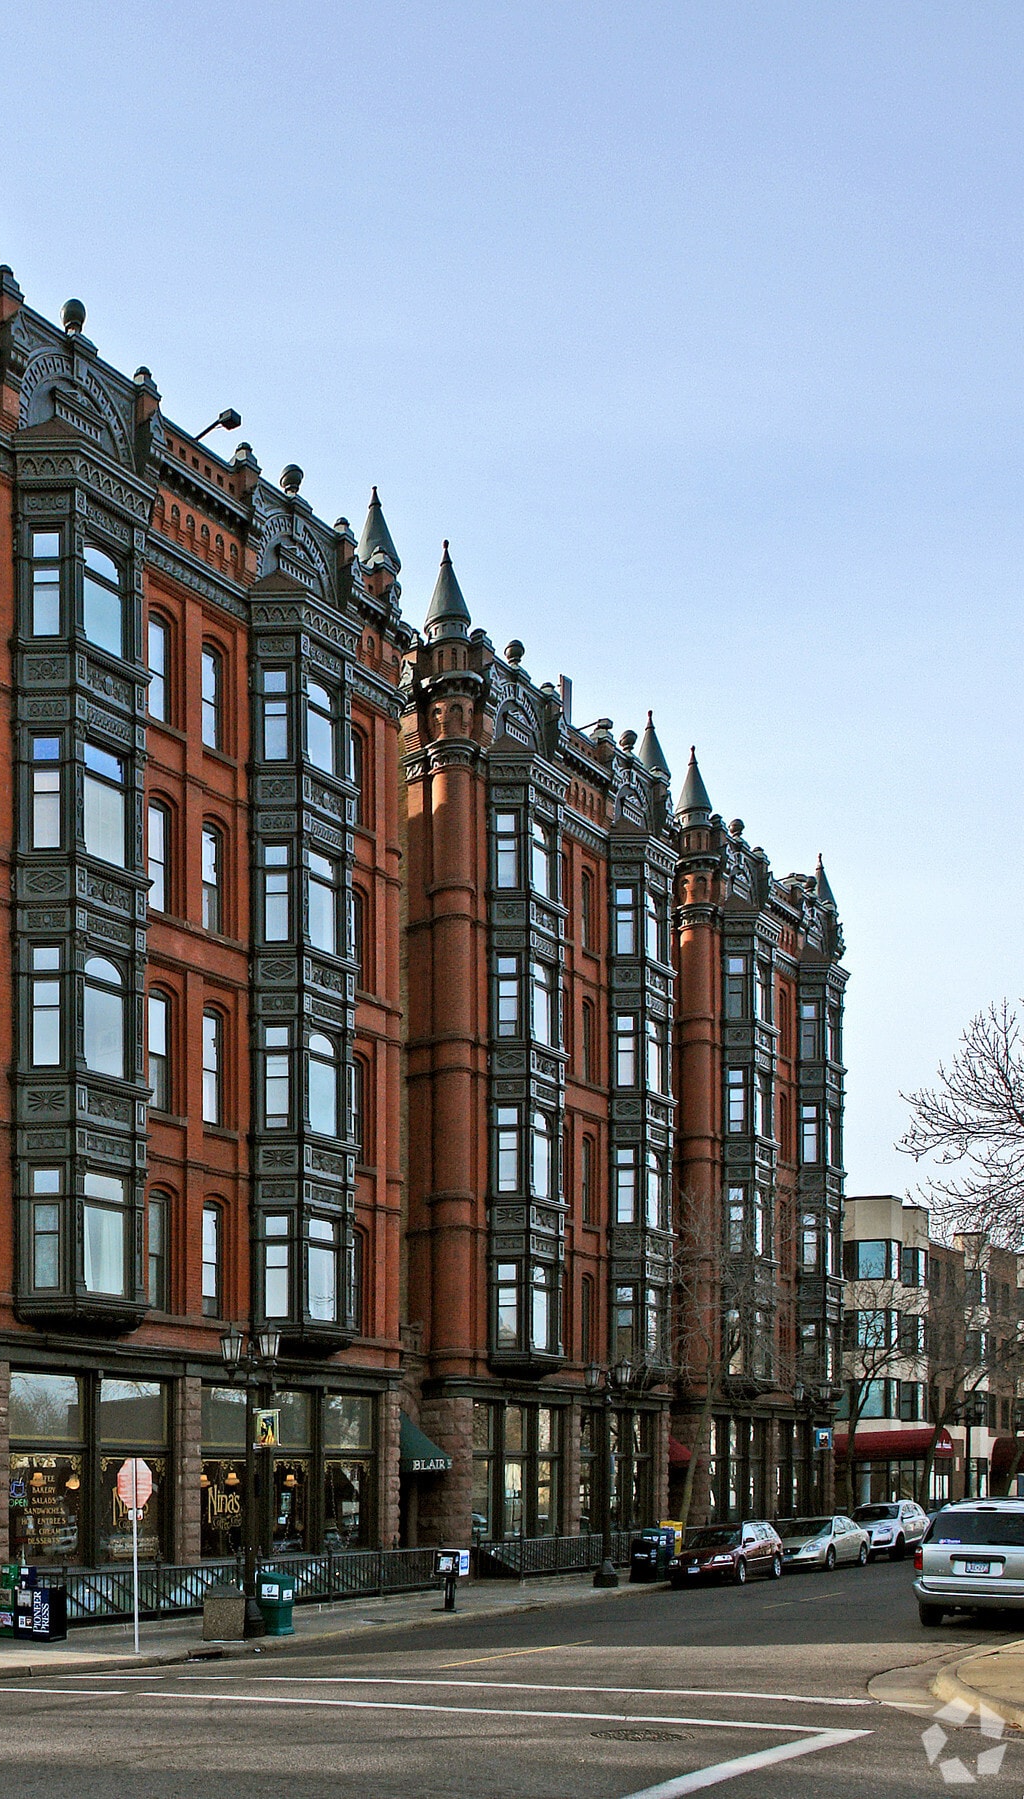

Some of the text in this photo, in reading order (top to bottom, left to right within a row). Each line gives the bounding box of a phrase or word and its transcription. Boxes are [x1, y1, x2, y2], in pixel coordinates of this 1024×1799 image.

[412, 1459, 445, 1470] BLAIR
[9, 1499, 28, 1507] OPEN
[208, 1484, 240, 1523] Nina's
[33, 1591, 42, 1632] PIONEER
[41, 1603, 50, 1633] PRESS
